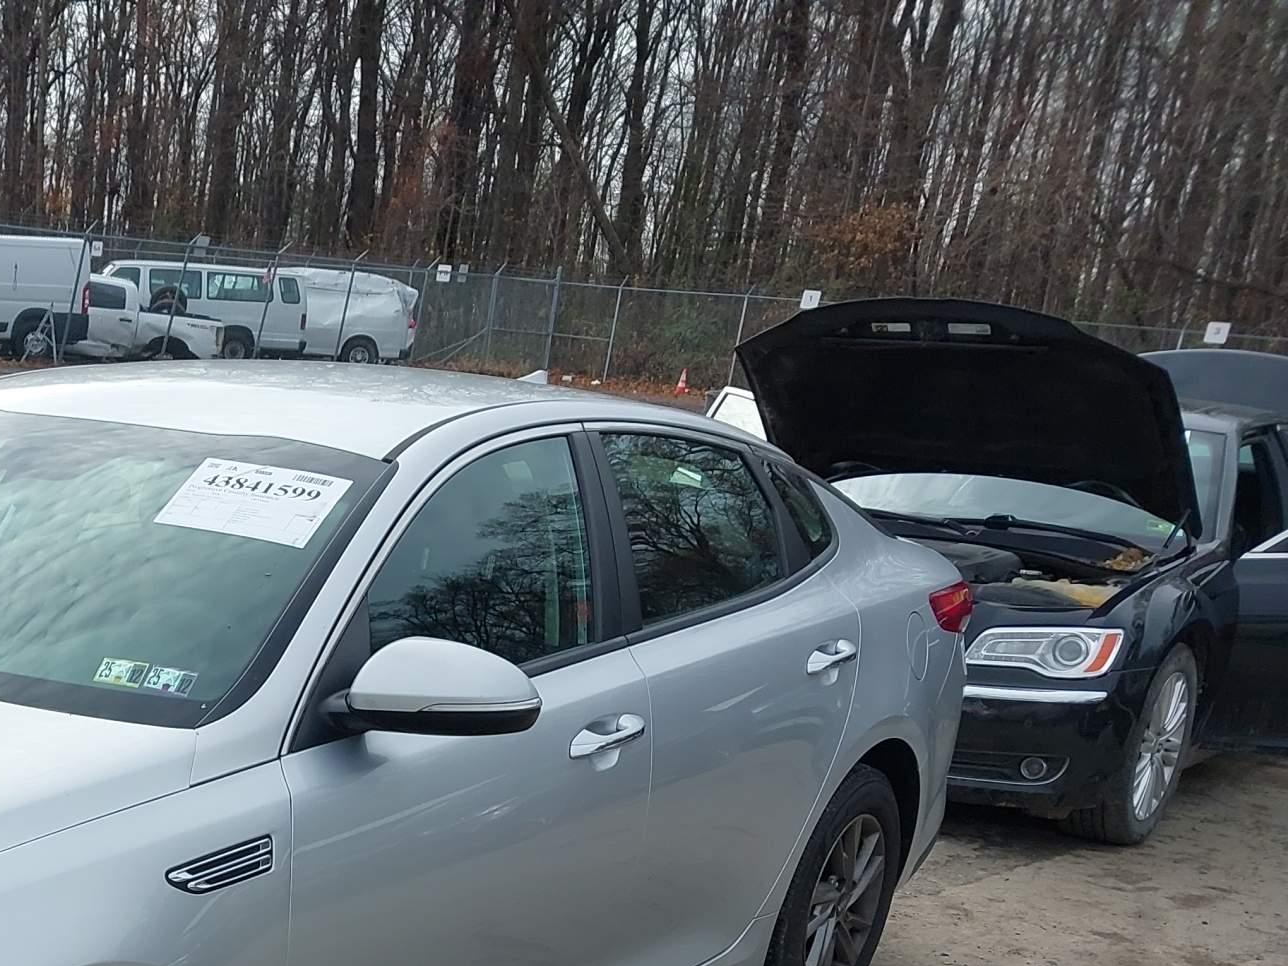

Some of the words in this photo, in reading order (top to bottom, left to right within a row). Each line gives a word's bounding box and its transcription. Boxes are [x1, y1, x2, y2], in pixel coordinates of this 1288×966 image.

[203, 474, 322, 502] 43841599
[99, 661, 116, 678] 25
[147, 668, 165, 685] 25
